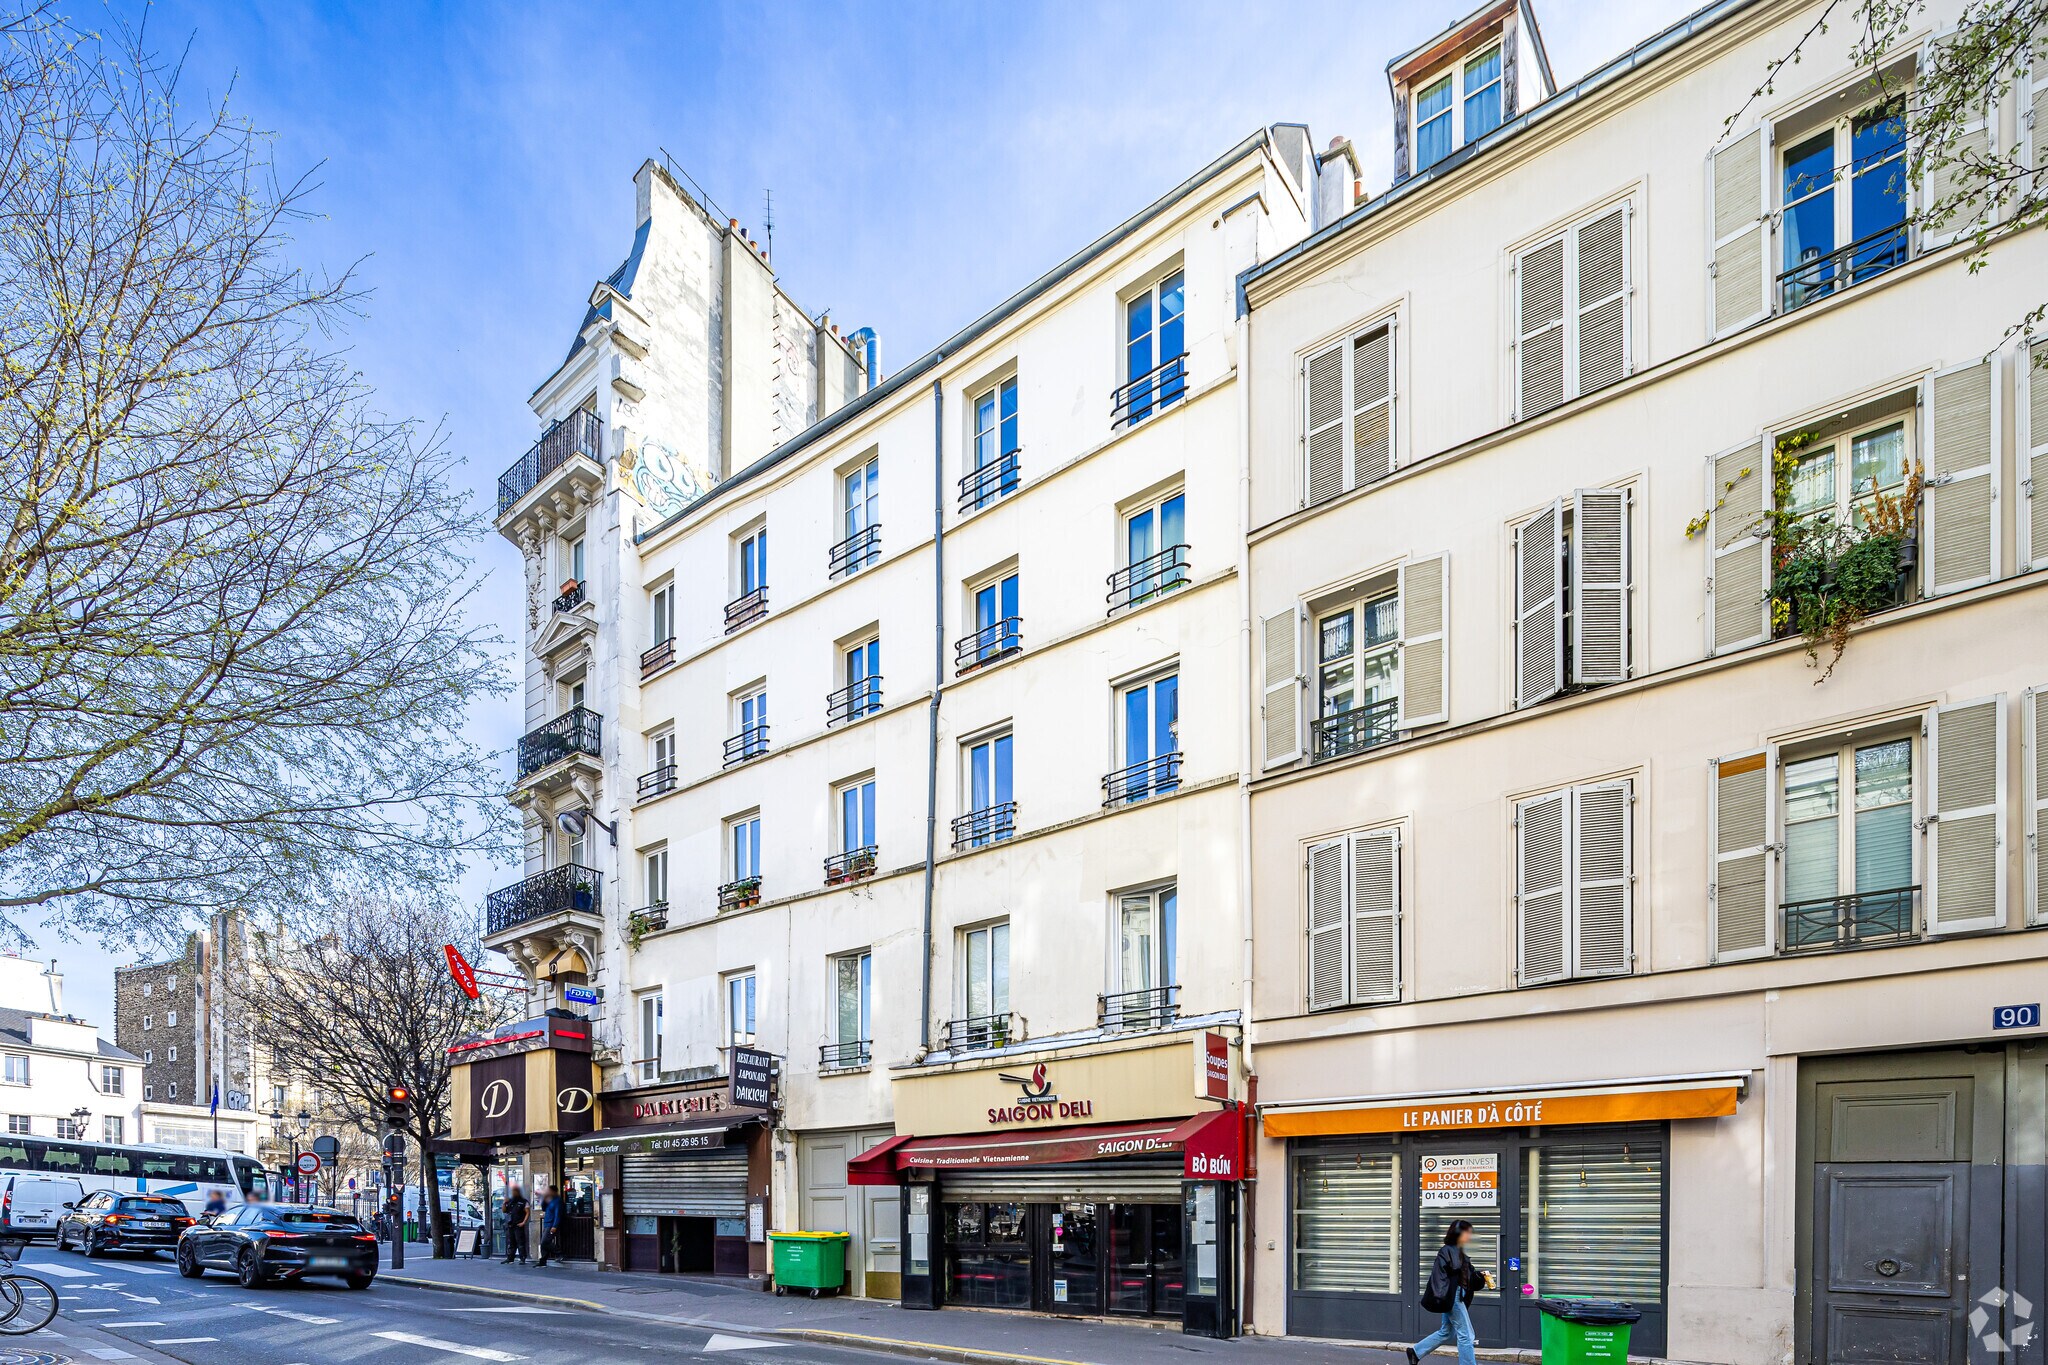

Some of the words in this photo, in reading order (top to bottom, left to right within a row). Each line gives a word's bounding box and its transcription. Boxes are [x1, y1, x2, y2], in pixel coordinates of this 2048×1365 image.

[451, 954, 473, 989] TABAC
[550, 963, 558, 974] D
[571, 989, 585, 997] FDJ
[2000, 1007, 2032, 1027] 90
[736, 1052, 770, 1068] RESTAURANT
[1206, 1051, 1228, 1069] Soupes
[738, 1069, 767, 1082] JAPONAIS
[1206, 1070, 1220, 1079] SAIGON
[1219, 1073, 1228, 1081] DELI
[481, 1079, 514, 1118] D
[557, 1087, 593, 1114] D
[735, 1085, 768, 1103] DAIKICHI
[633, 1097, 708, 1119] DAIKICHI
[988, 1104, 1053, 1123] SAIGON
[1059, 1100, 1092, 1118] DELI
[1403, 1111, 1419, 1127] LE
[1423, 1108, 1473, 1126] PANIER
[1478, 1103, 1500, 1123] D'À
[1505, 1100, 1543, 1122] CÔTÉ
[663, 1139, 671, 1148] 01
[671, 1139, 681, 1148] 45
[680, 1138, 690, 1147] 26
[690, 1137, 700, 1146] 95
[700, 1136, 709, 1145] 15
[1097, 1139, 1144, 1154] SAIGON
[576, 1147, 590, 1155] Plats
[595, 1145, 620, 1154] Emporter
[936, 1157, 980, 1165] Traditionnelle
[982, 1155, 1030, 1163] Vietnamienne
[1192, 1152, 1208, 1174] BÒ
[1209, 1154, 1231, 1175] BÚN
[1465, 1157, 1495, 1166] INVEST
[1438, 1172, 1480, 1181] LOCAUX
[1427, 1180, 1492, 1190] DISPONIBLES
[1425, 1192, 1436, 1200] 01
[1437, 1192, 1450, 1200] 40
[1452, 1191, 1464, 1200] 59
[1465, 1191, 1479, 1200] 09
[1480, 1191, 1494, 1200] 08
